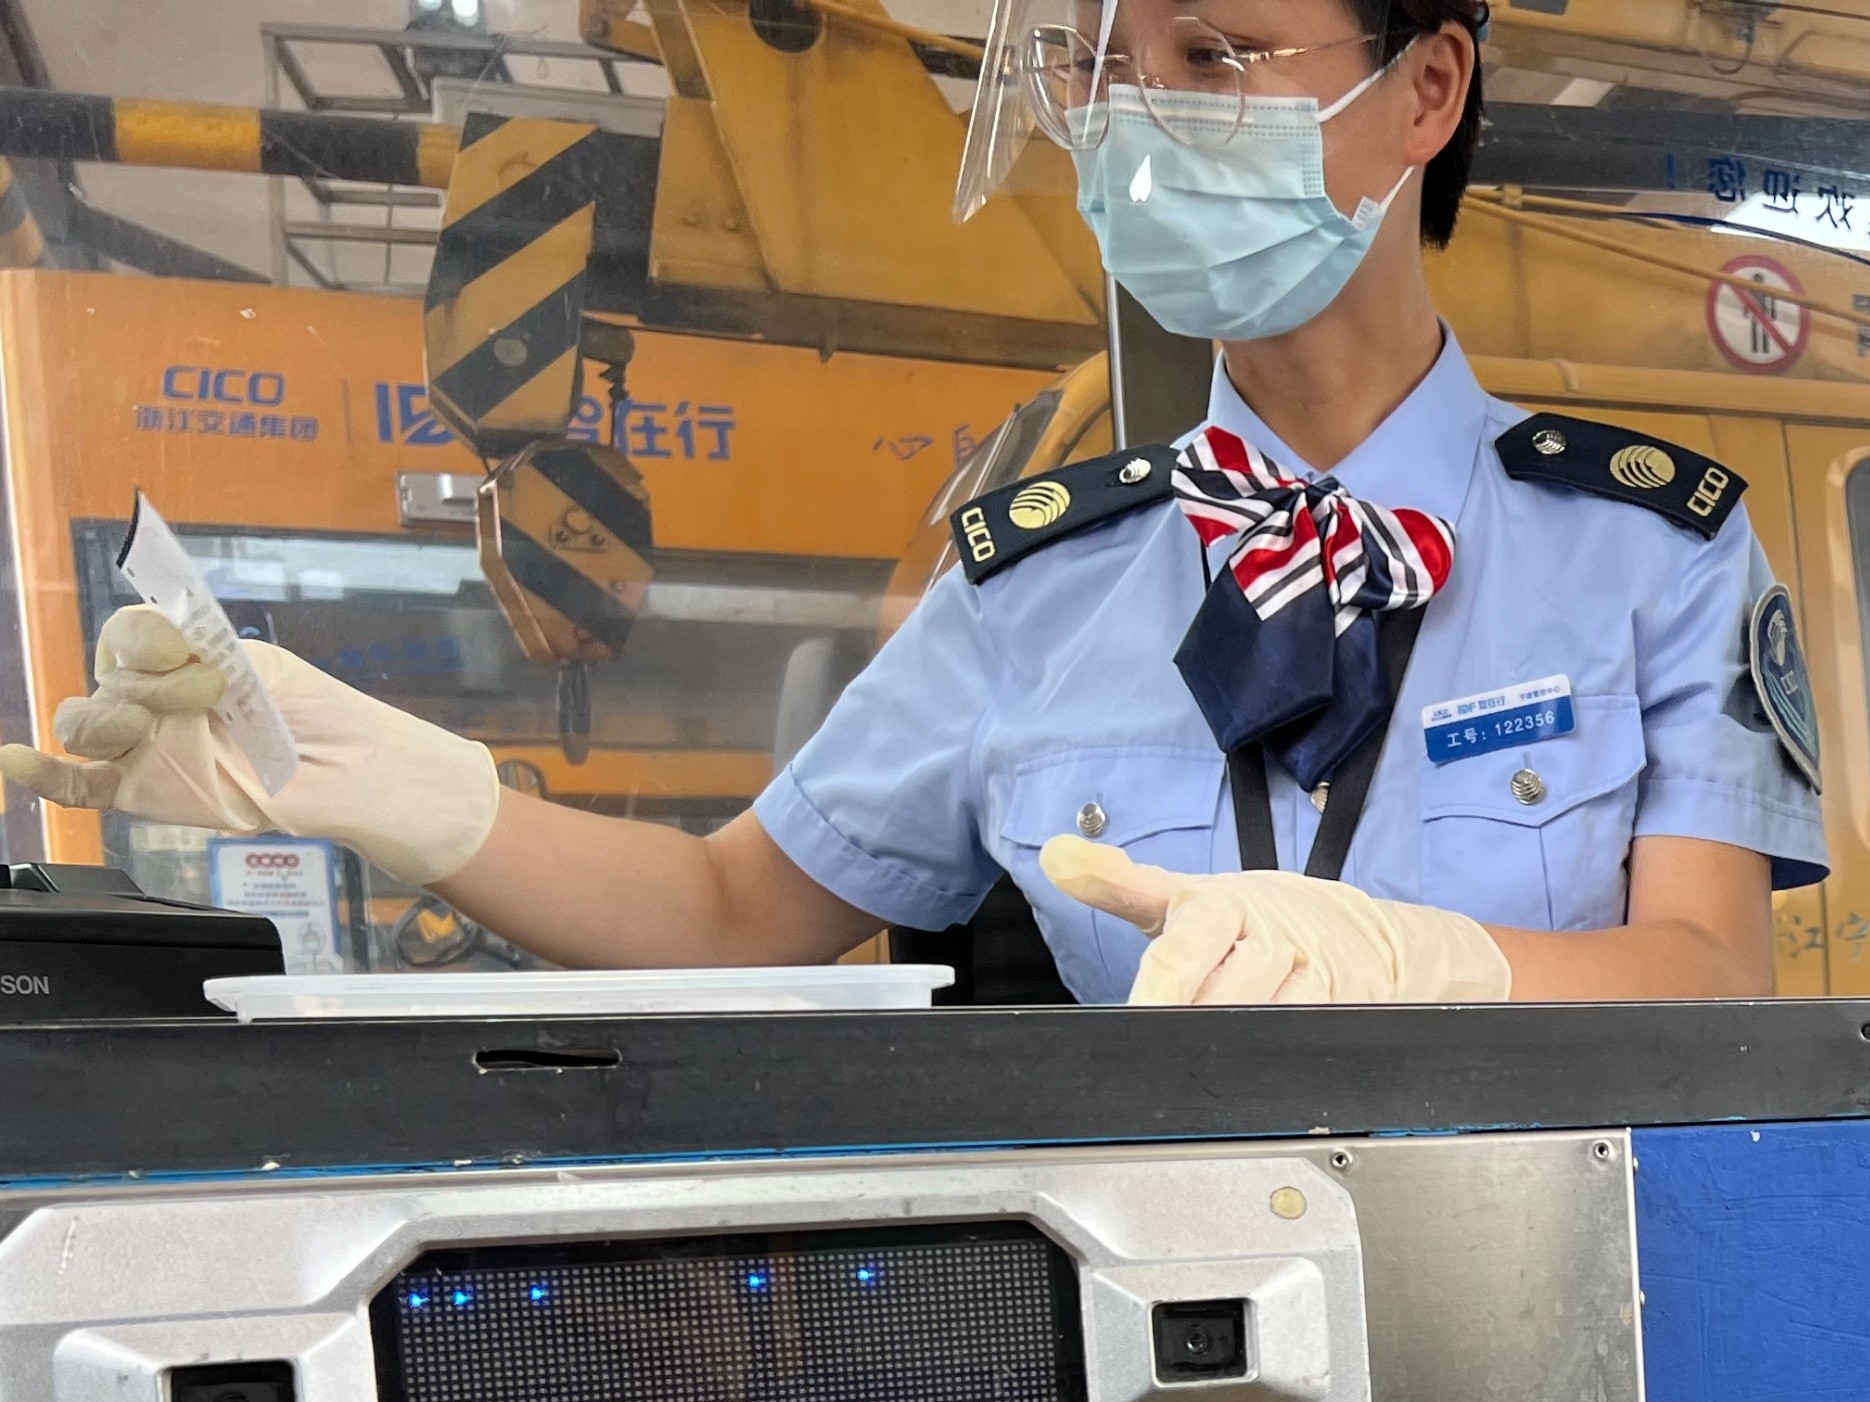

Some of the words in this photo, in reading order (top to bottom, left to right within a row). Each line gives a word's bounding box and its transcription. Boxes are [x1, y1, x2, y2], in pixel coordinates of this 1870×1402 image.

[163, 364, 285, 407] CICO
[135, 406, 319, 442] 浙江交通集团
[1686, 465, 1730, 517] CICO
[961, 506, 996, 563] CICO
